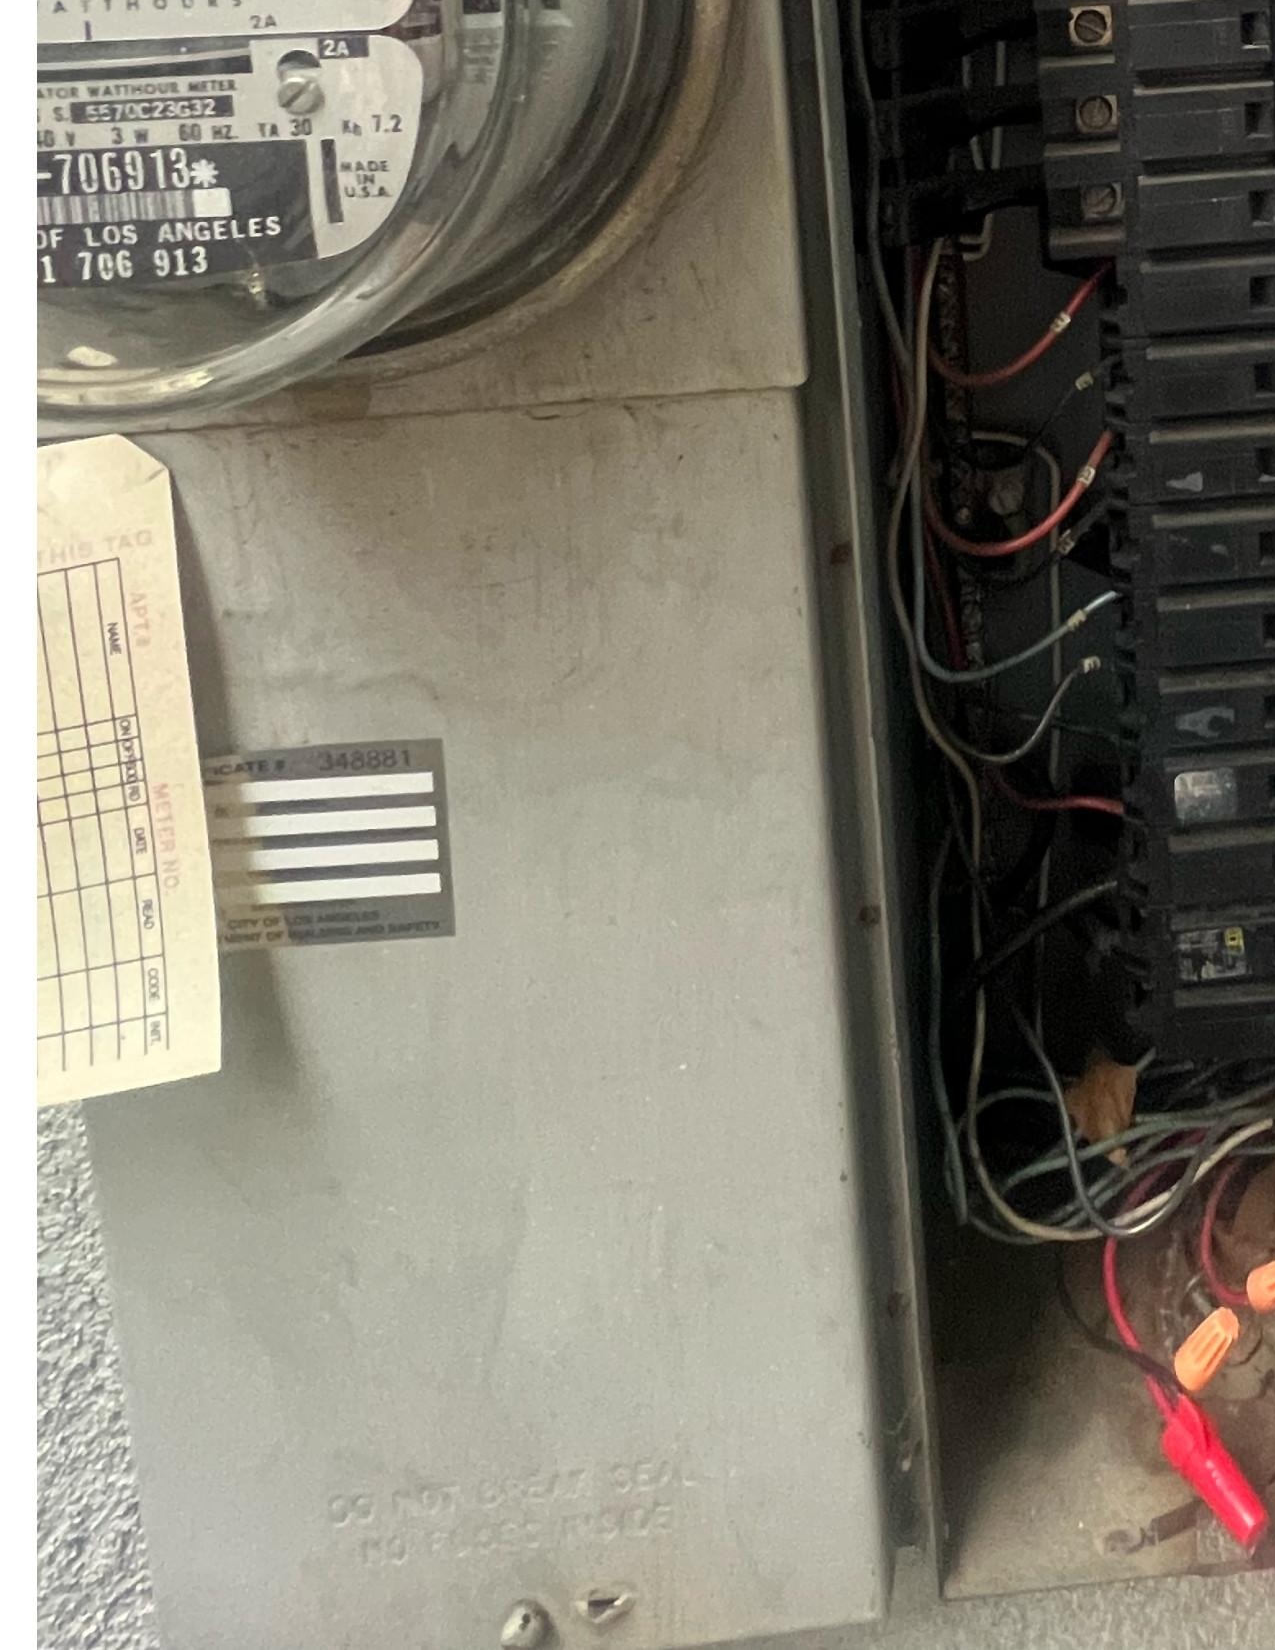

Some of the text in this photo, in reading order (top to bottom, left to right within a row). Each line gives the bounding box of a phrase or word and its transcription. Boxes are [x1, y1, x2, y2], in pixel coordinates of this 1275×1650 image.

[250, 14, 277, 29] 2A
[322, 39, 350, 57] 2A
[87, 82, 180, 98] WATTHOUR
[188, 79, 237, 93] METER
[111, 126, 124, 145] 3
[178, 123, 202, 142] 60
[258, 122, 280, 137] TA
[289, 118, 313, 136] 30
[371, 114, 403, 133] 7.2
[340, 160, 390, 172] MADE
[356, 173, 376, 185] IN
[84, 224, 138, 247] LOS
[158, 216, 282, 243] ANGELES
[78, 250, 134, 281] 706
[153, 246, 209, 277] 913
[107, 622, 122, 655] NAME
[119, 718, 132, 736] ON
[153, 782, 176, 853] METER
[133, 826, 148, 854] DATE
[142, 898, 155, 930] READ
[148, 967, 161, 1001] CODE
